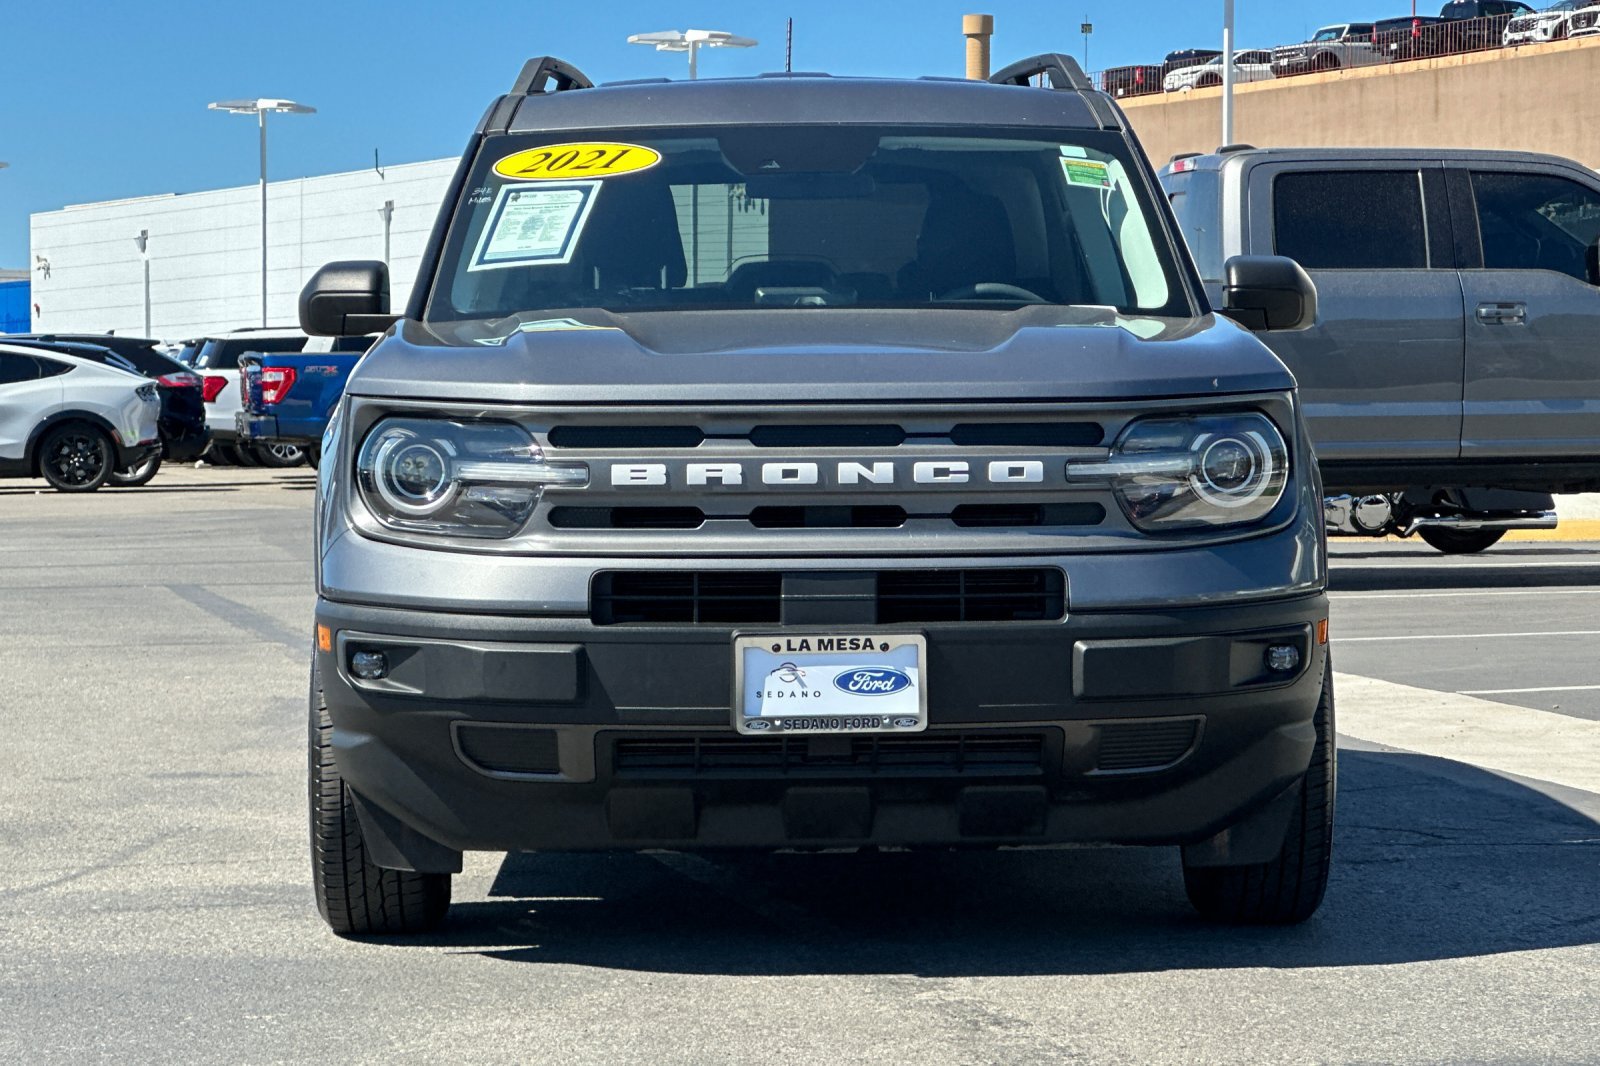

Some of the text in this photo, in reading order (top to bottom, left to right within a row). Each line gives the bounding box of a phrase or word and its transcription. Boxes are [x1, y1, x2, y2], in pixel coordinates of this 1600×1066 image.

[516, 149, 633, 174] 2021
[611, 461, 1044, 485] BRONCO
[786, 638, 875, 652] LA MESA
[848, 671, 895, 691] Ford
[756, 690, 821, 698] SEDANO
[784, 717, 881, 730] SEDANO FORD
